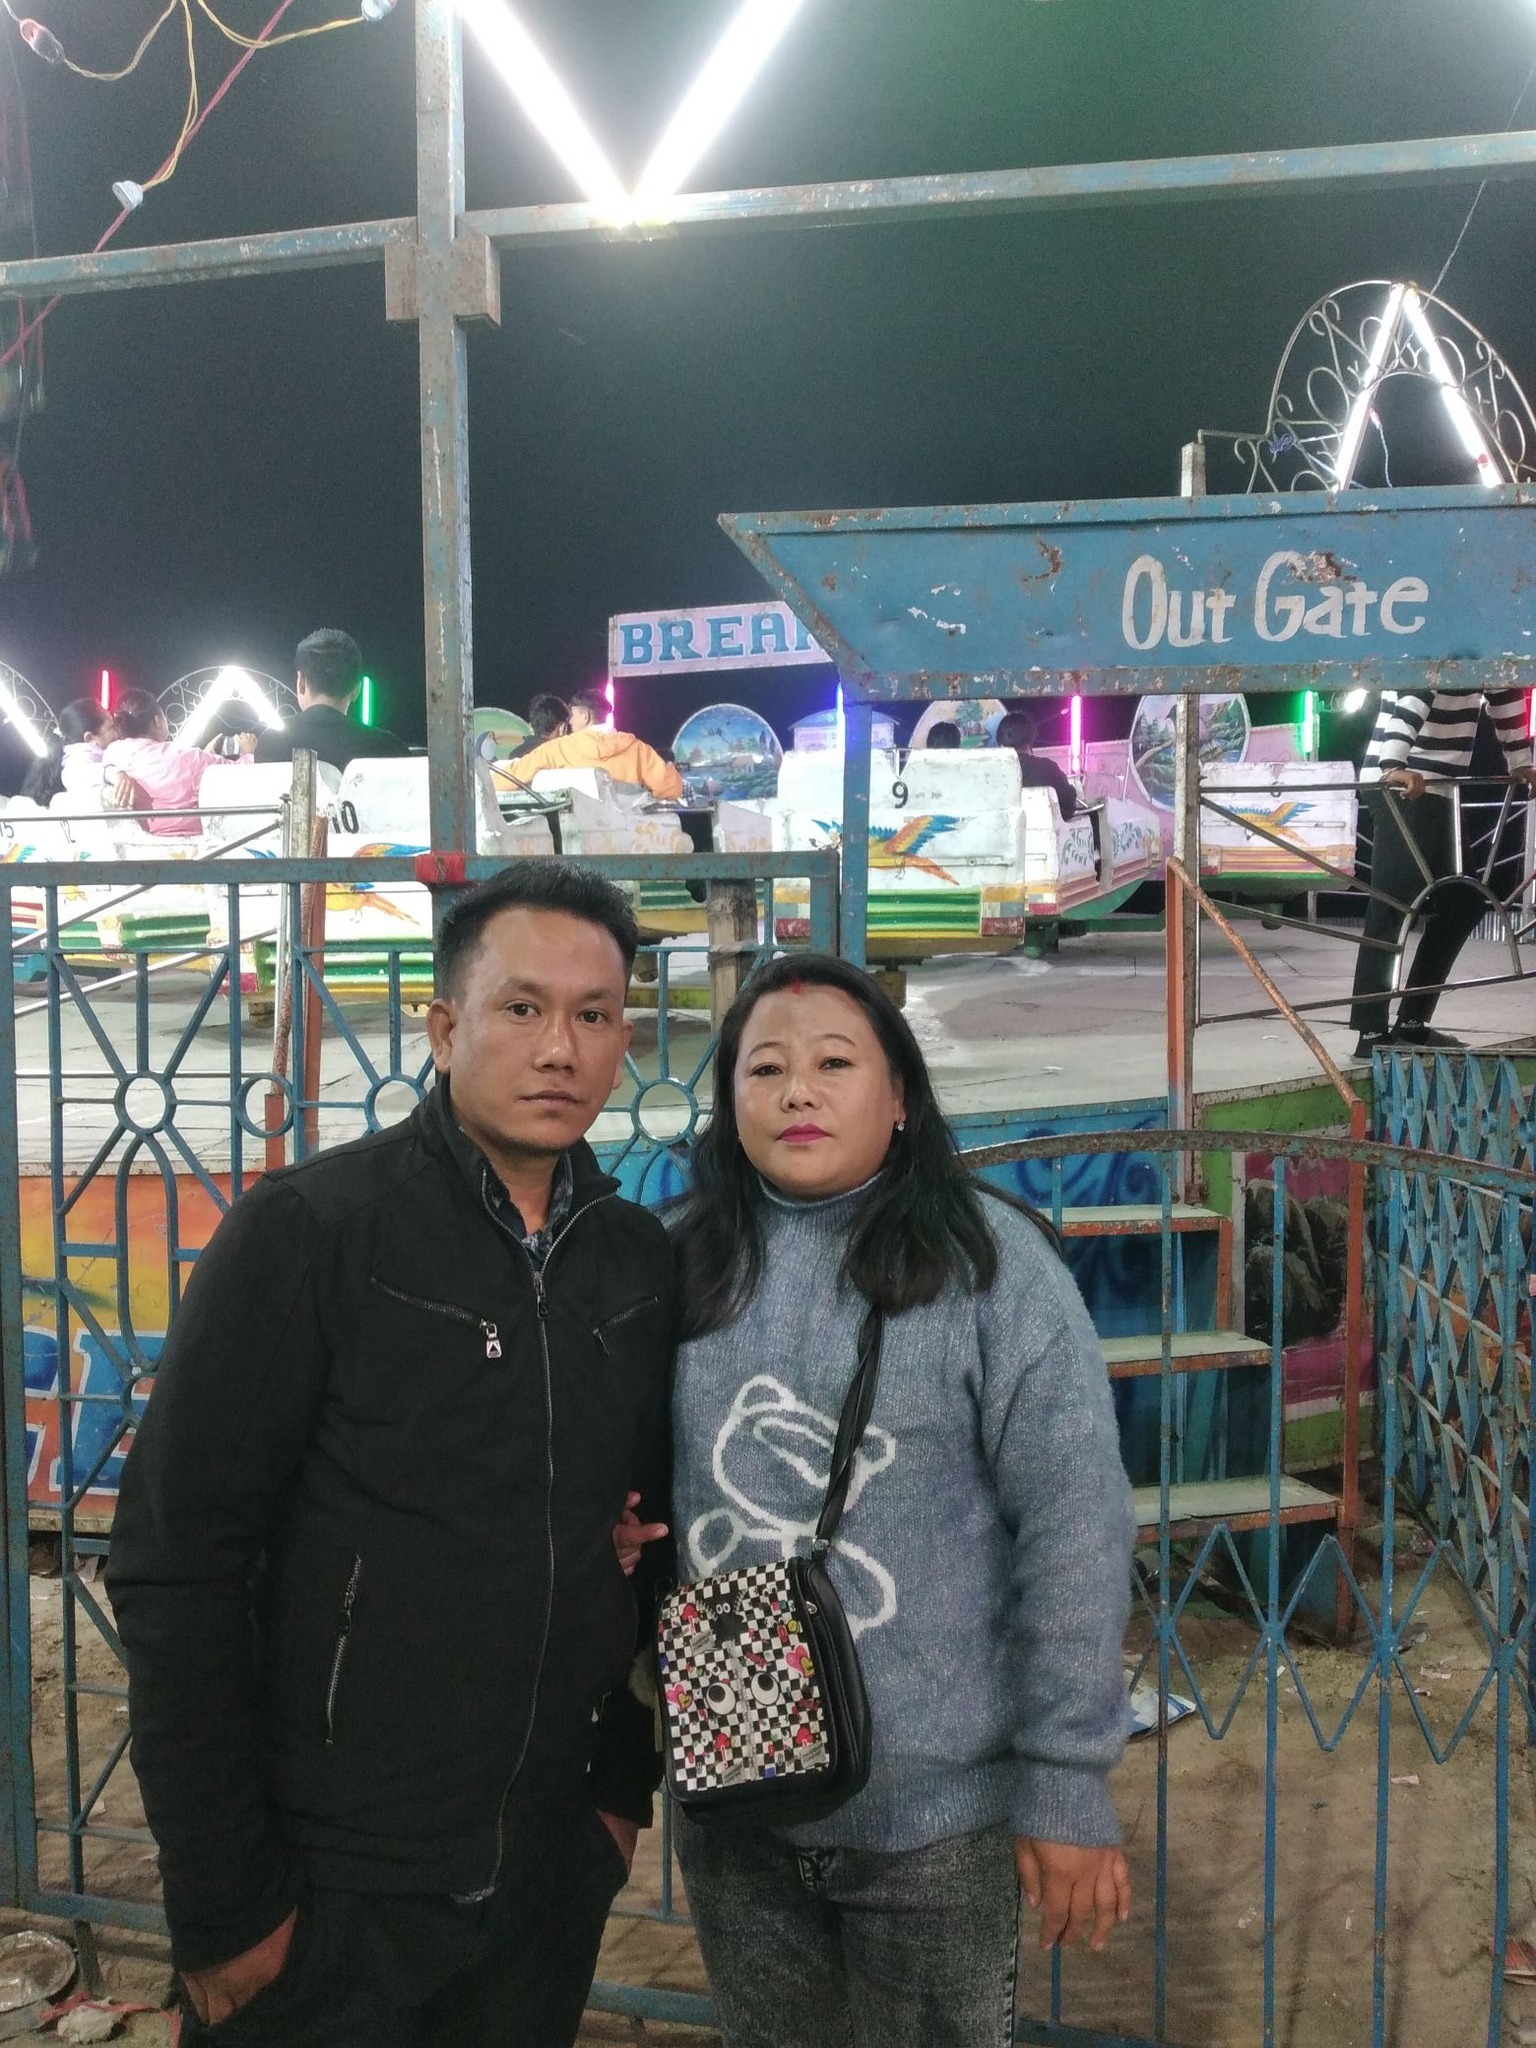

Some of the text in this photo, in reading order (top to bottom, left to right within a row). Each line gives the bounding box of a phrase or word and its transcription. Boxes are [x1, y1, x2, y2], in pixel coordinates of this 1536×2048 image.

[1122, 551, 1429, 650] Out Gate
[891, 780, 908, 809] 9
[327, 800, 360, 835] 10
